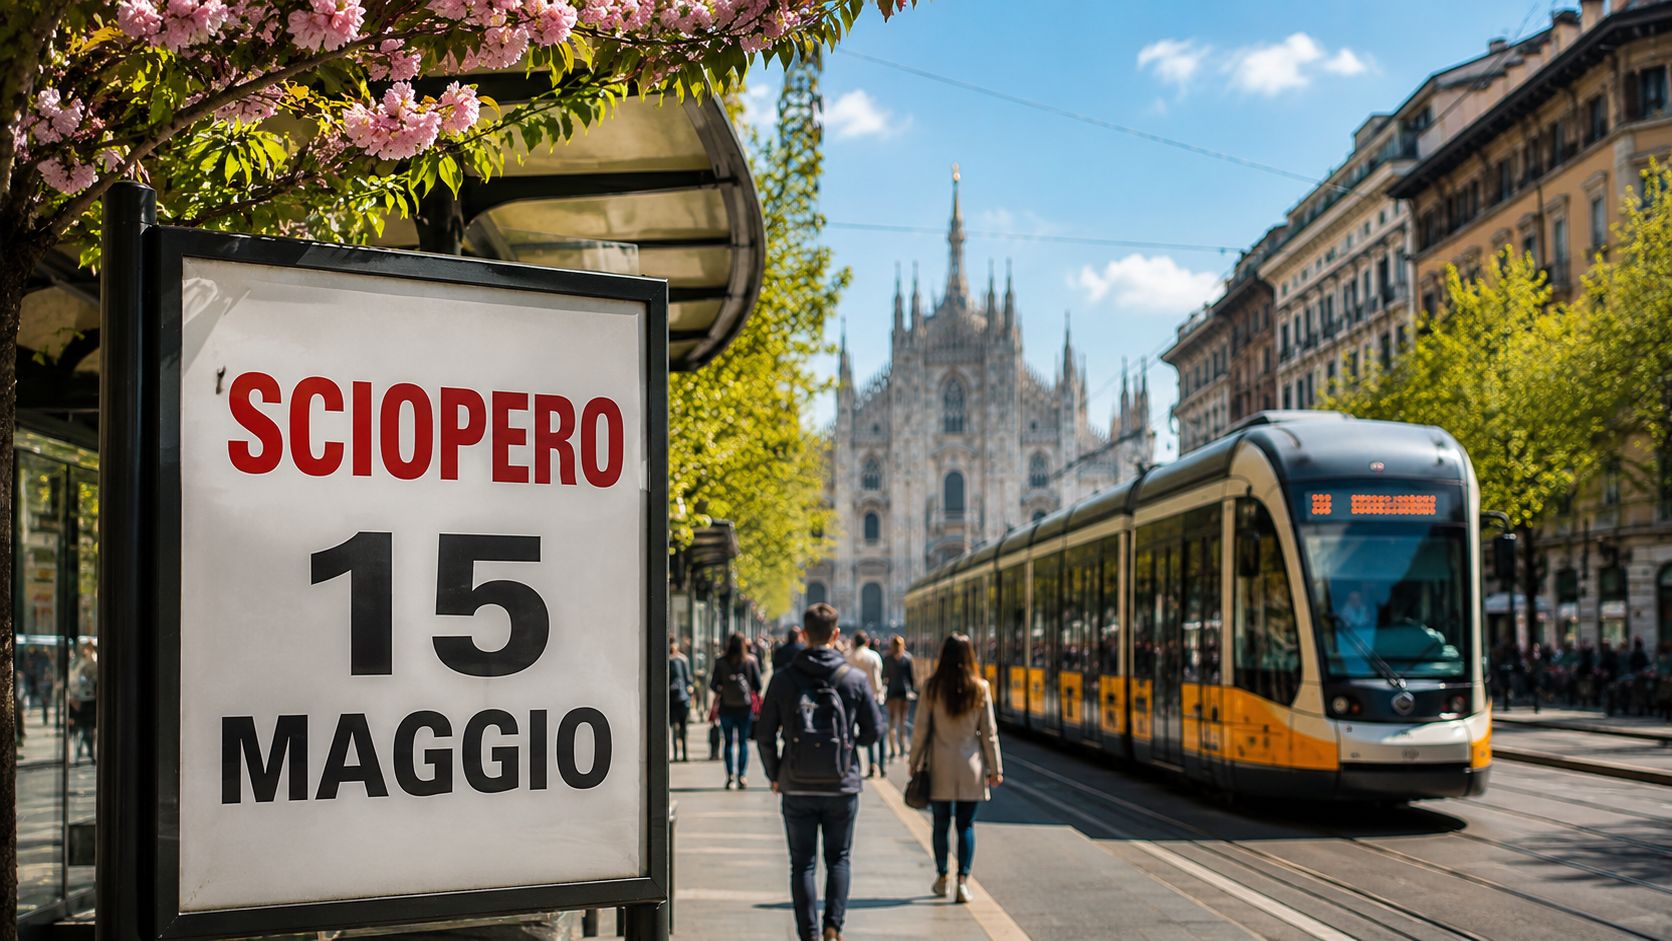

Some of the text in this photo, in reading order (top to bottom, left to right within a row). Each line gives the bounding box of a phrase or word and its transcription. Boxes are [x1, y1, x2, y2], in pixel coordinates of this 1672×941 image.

[228, 372, 623, 487] SCIOPERO
[311, 532, 550, 678] 15
[222, 707, 613, 804] MAGGIO
